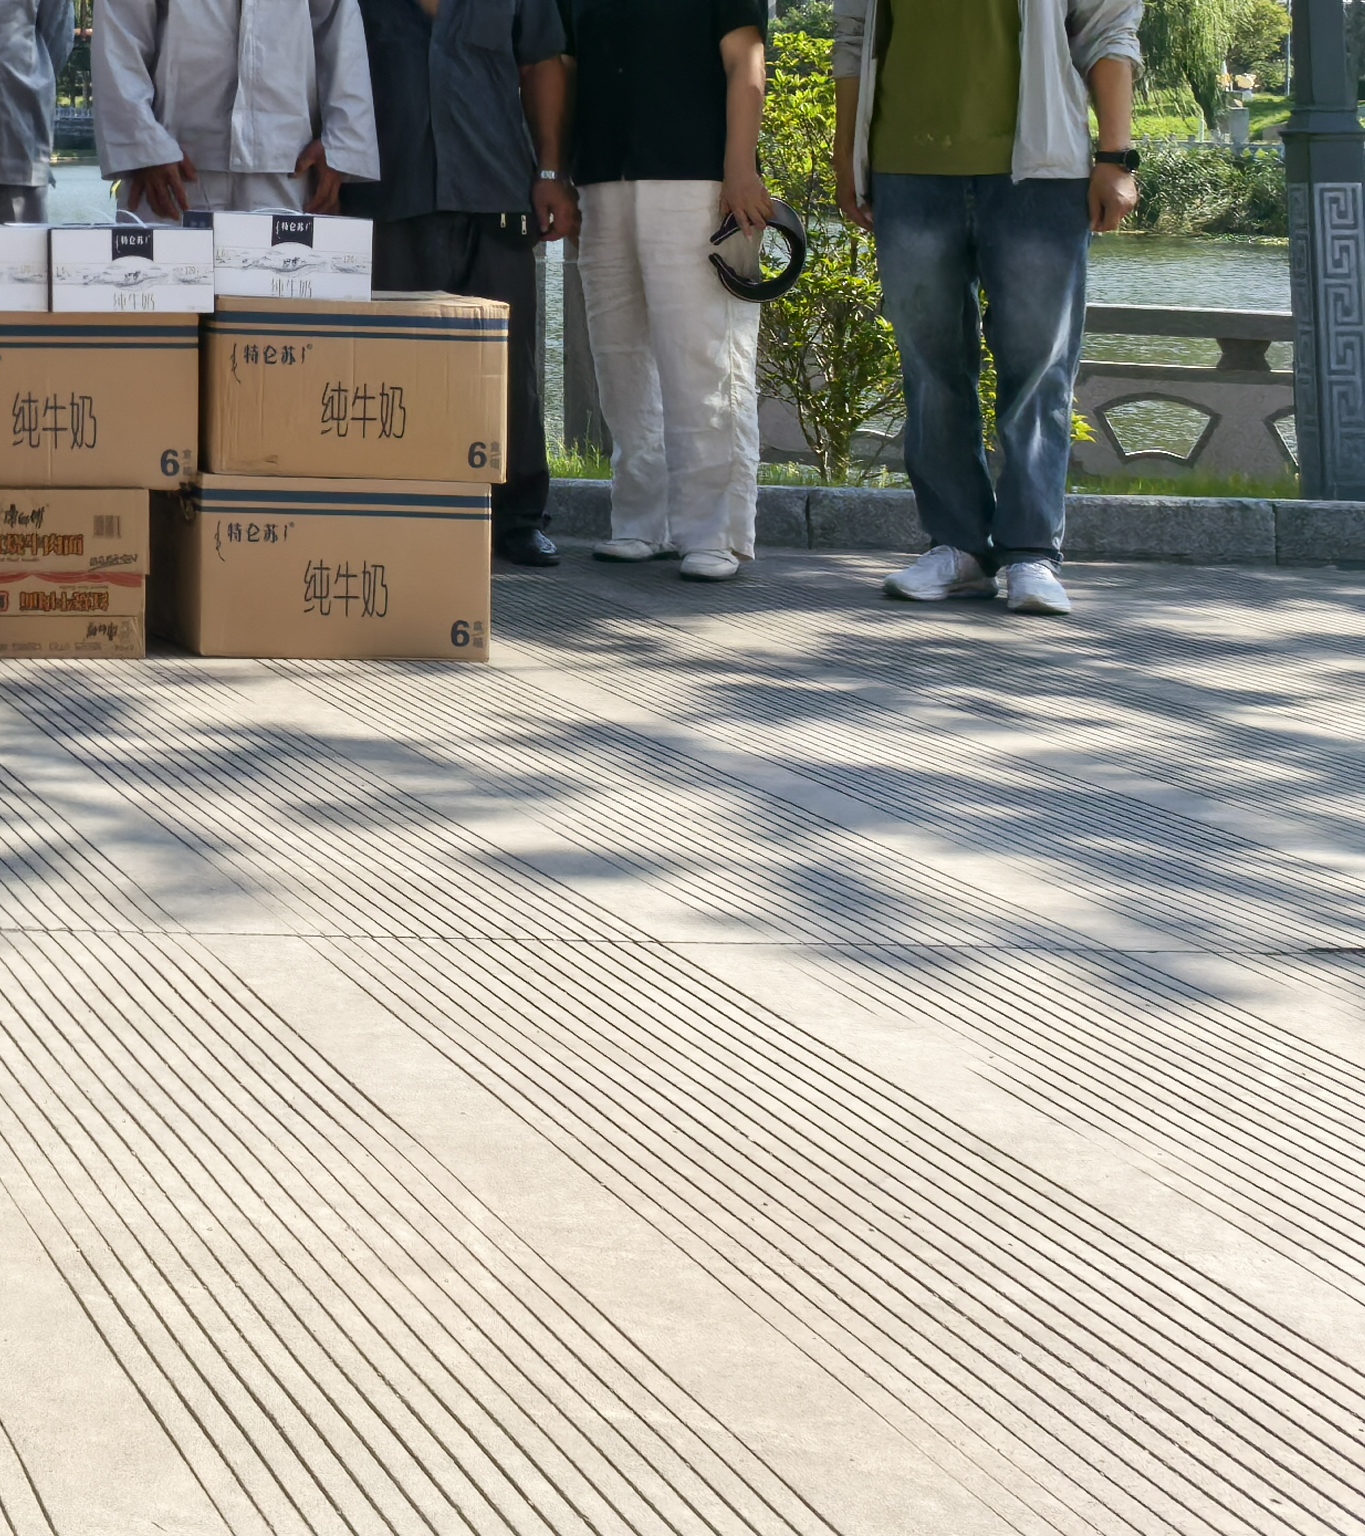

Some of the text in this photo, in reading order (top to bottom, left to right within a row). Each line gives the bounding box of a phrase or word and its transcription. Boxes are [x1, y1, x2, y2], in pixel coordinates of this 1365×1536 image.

[243, 344, 297, 365] 特仑苏
[12, 391, 97, 450] 纯牛奶
[321, 381, 407, 439] 纯牛奶
[160, 448, 180, 477] 6
[467, 441, 487, 469] 6
[227, 523, 279, 544] 特仑苏
[303, 559, 389, 618] 纯牛奶
[450, 619, 471, 647] 6
